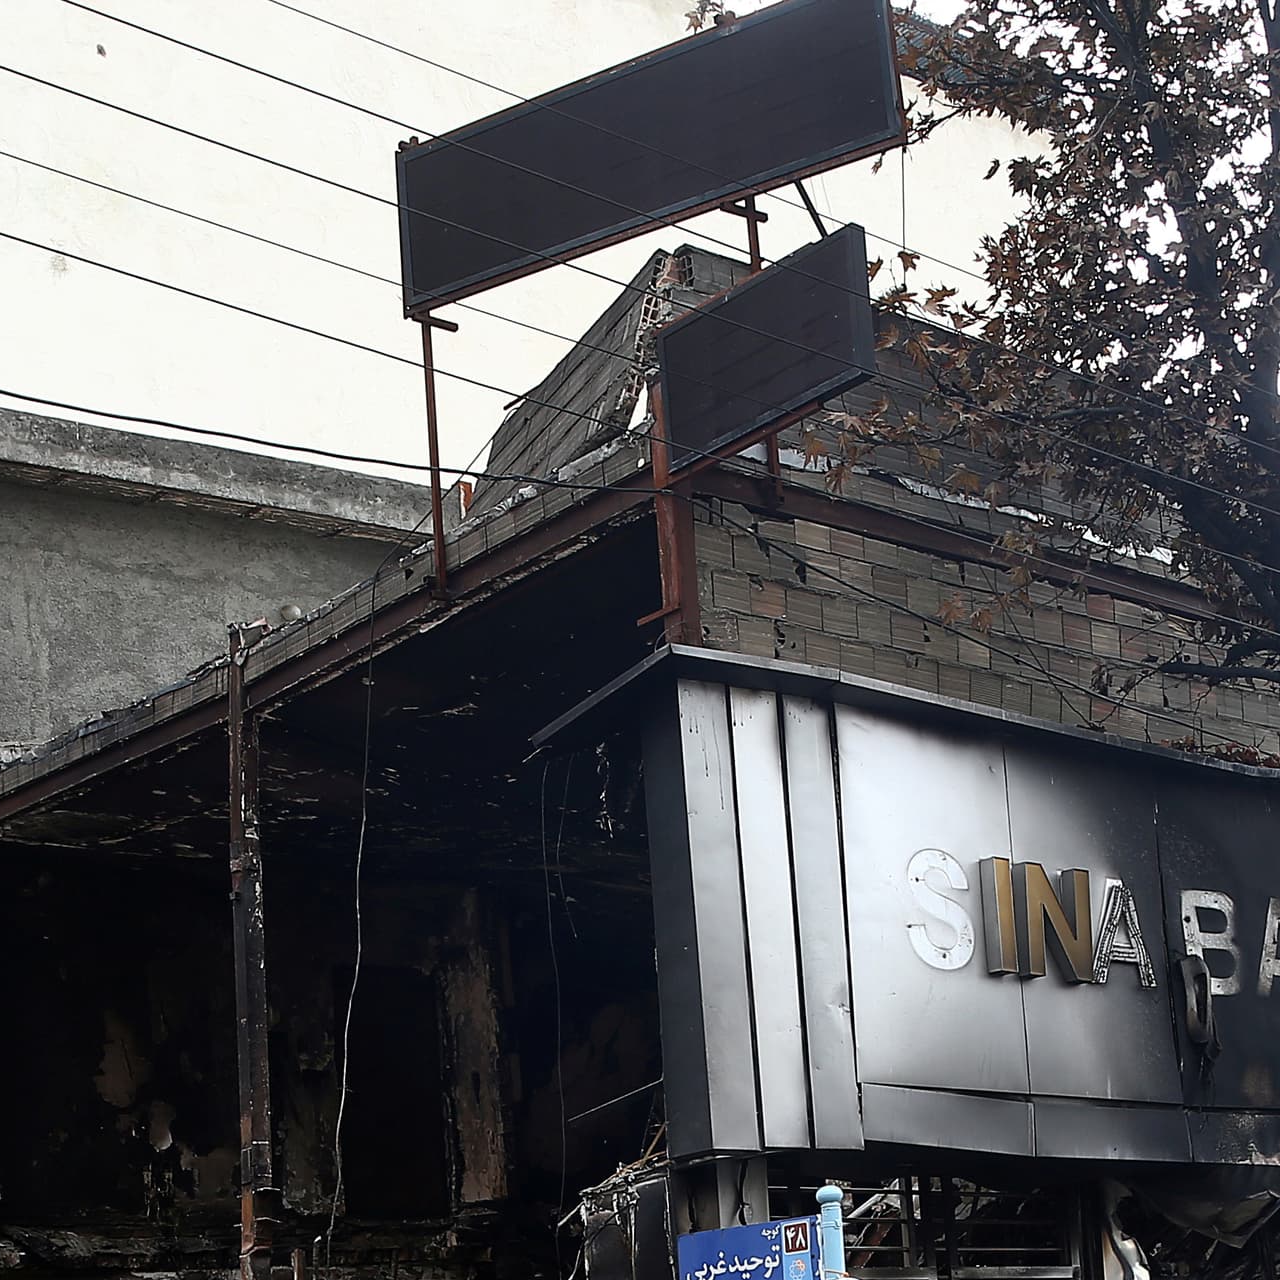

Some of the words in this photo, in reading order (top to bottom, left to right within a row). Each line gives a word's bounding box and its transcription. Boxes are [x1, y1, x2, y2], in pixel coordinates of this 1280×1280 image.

[905, 848, 1158, 988] SINA
[761, 1224, 781, 1240] کوچه
[786, 1227, 806, 1250] ۴۸
[728, 1244, 781, 1280] توحید
